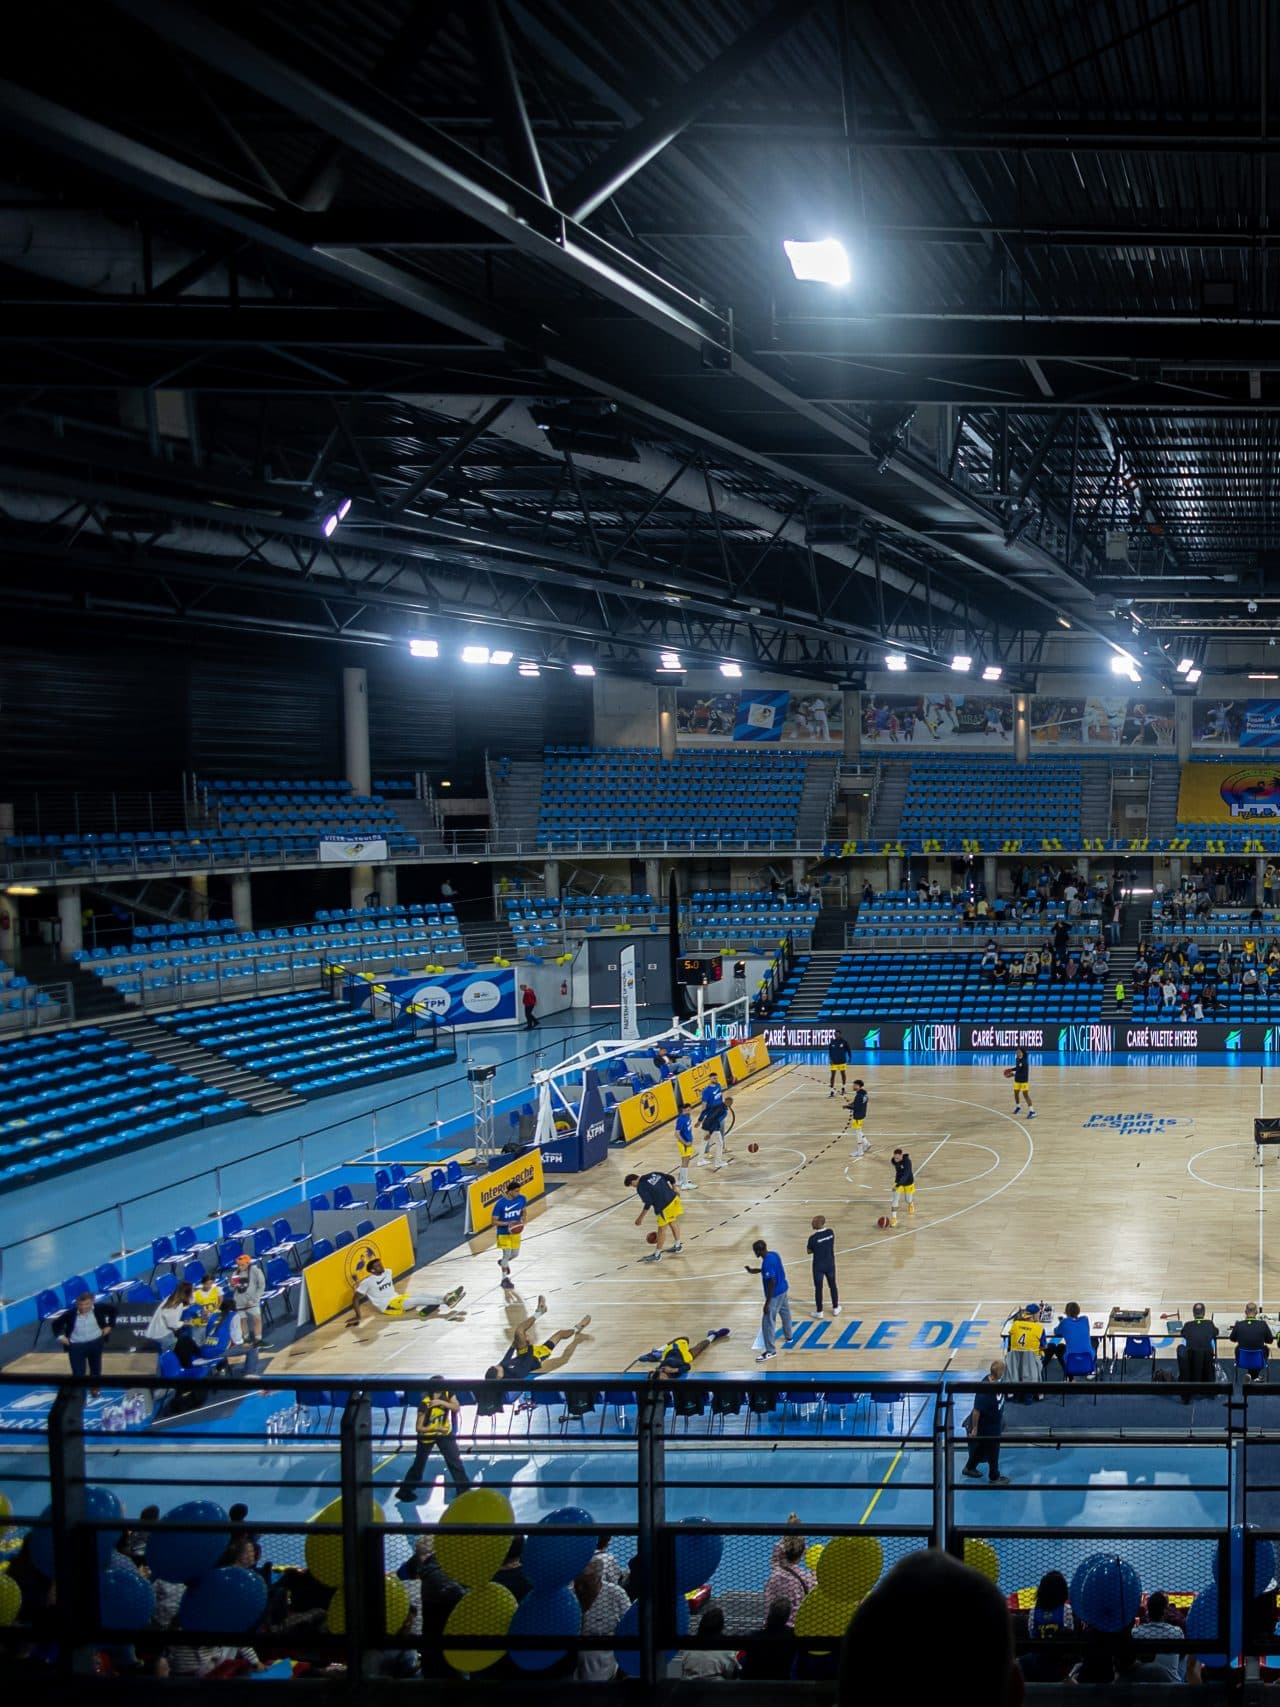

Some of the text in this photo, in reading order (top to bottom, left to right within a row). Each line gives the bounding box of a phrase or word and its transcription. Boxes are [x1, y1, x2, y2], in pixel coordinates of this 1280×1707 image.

[763, 1025, 786, 1046] CARRÉ
[971, 1025, 994, 1046] CARRÉ
[1019, 1029, 1043, 1047] HYERES
[1127, 1026, 1149, 1047] CARRÉ
[1174, 1030, 1198, 1047] HYERES
[1090, 1112, 1153, 1123] Palais
[1109, 1118, 1177, 1129] Sports
[909, 1320, 990, 1350] DE
[1017, 1333, 1027, 1347] 4
